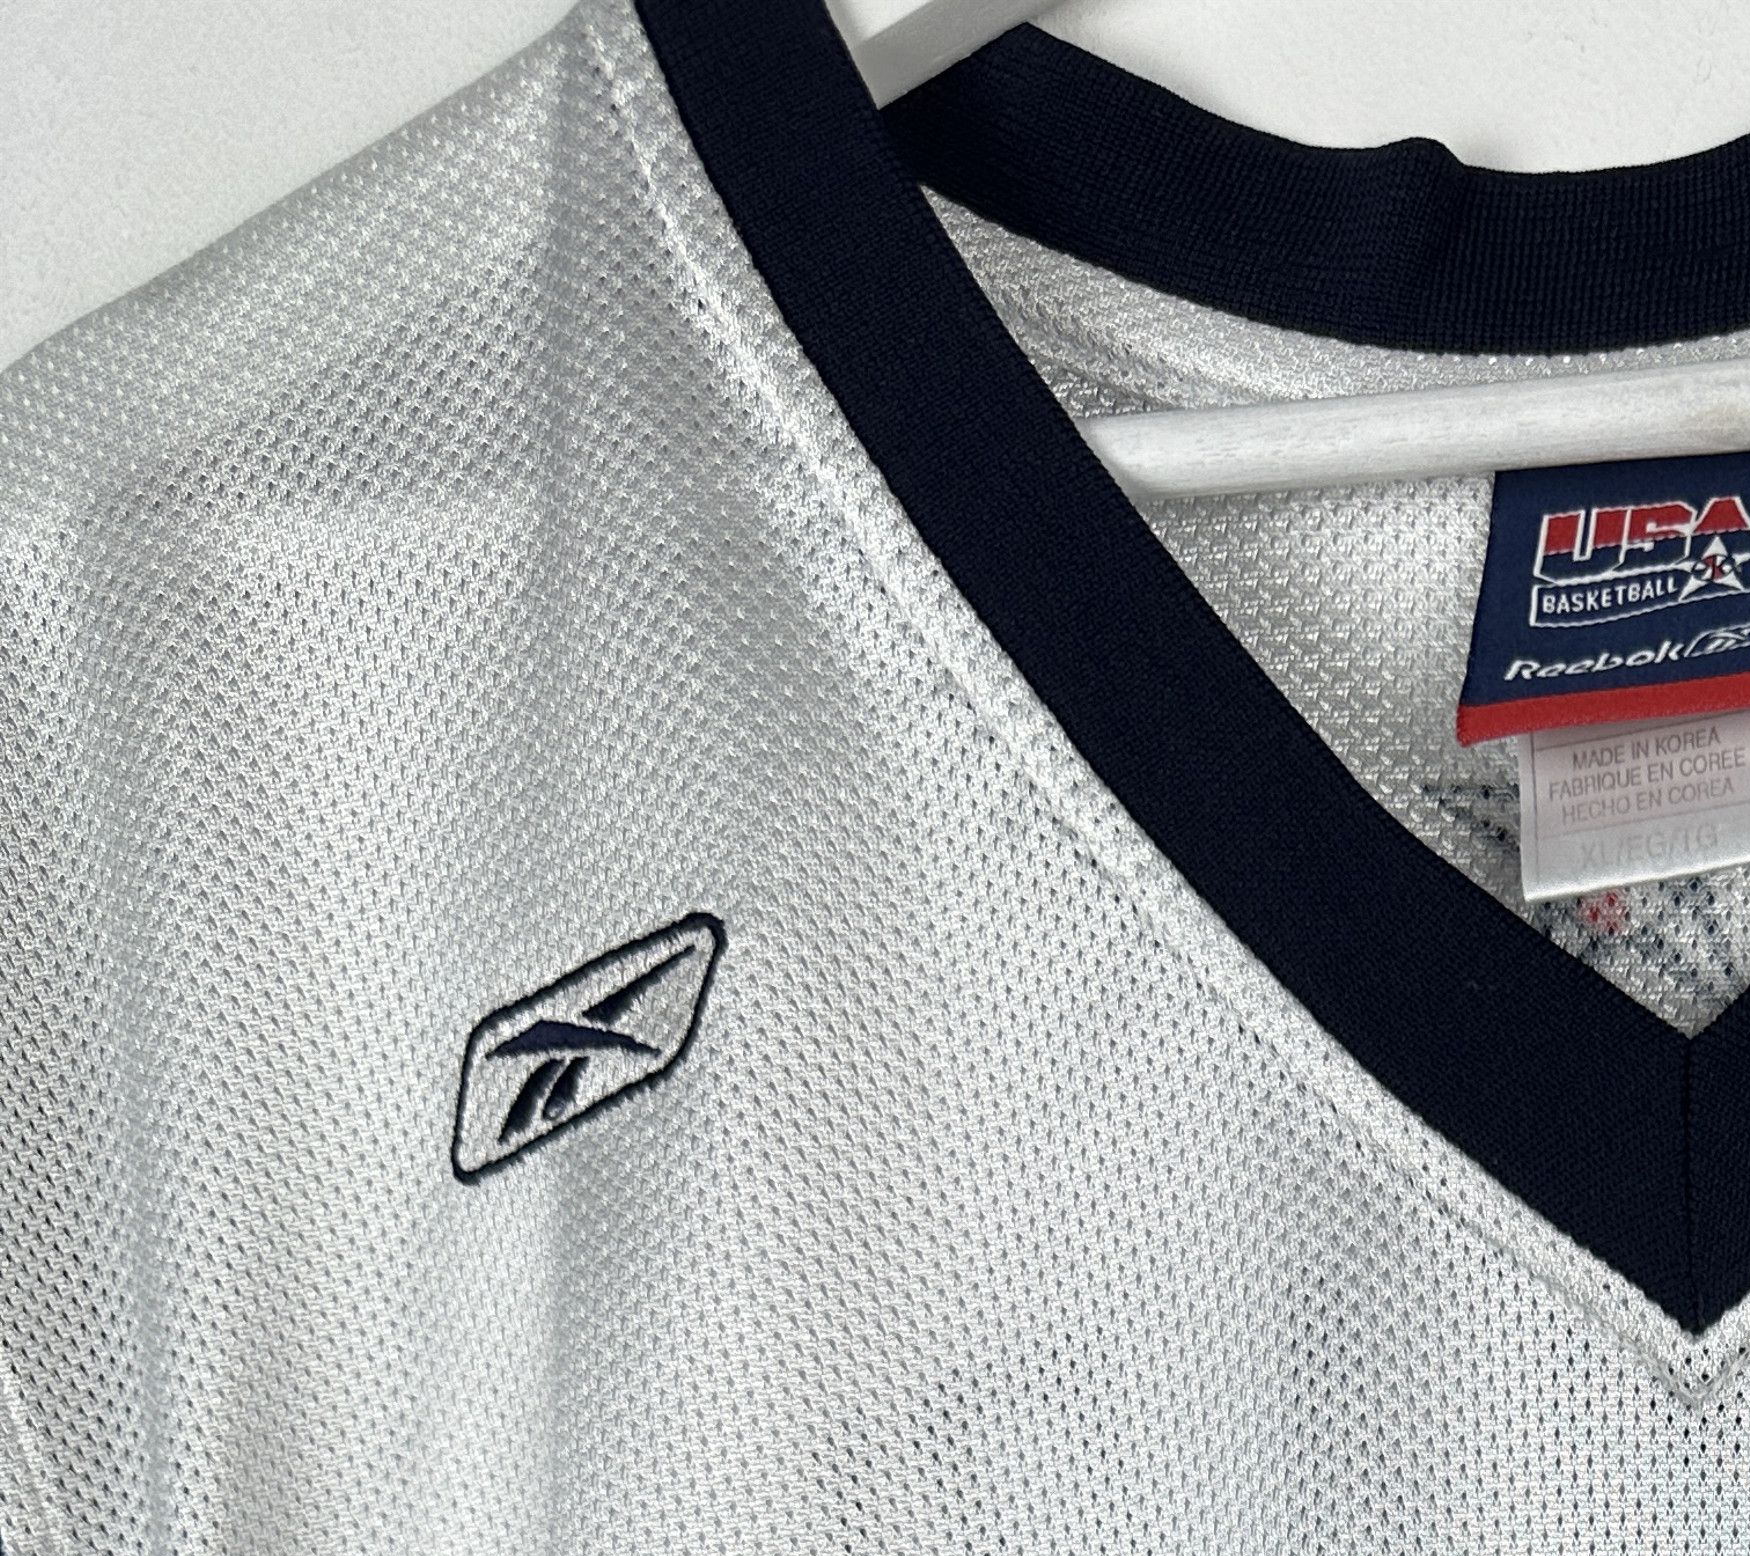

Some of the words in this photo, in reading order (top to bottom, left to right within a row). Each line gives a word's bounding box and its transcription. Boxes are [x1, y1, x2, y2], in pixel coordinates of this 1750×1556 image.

[1542, 575, 1679, 615] BASKETBALL
[1503, 640, 1684, 682] Reebok
[1571, 743, 1626, 771] MADE
[1631, 740, 1650, 761] IN
[1654, 726, 1721, 758] KOREA
[1548, 770, 1642, 802] FABRIQUE
[1647, 760, 1674, 783] EN
[1679, 746, 1747, 778] COREE
[1561, 795, 1631, 826] HECHO
[1636, 787, 1663, 812] EN
[1667, 776, 1735, 806] COREA
